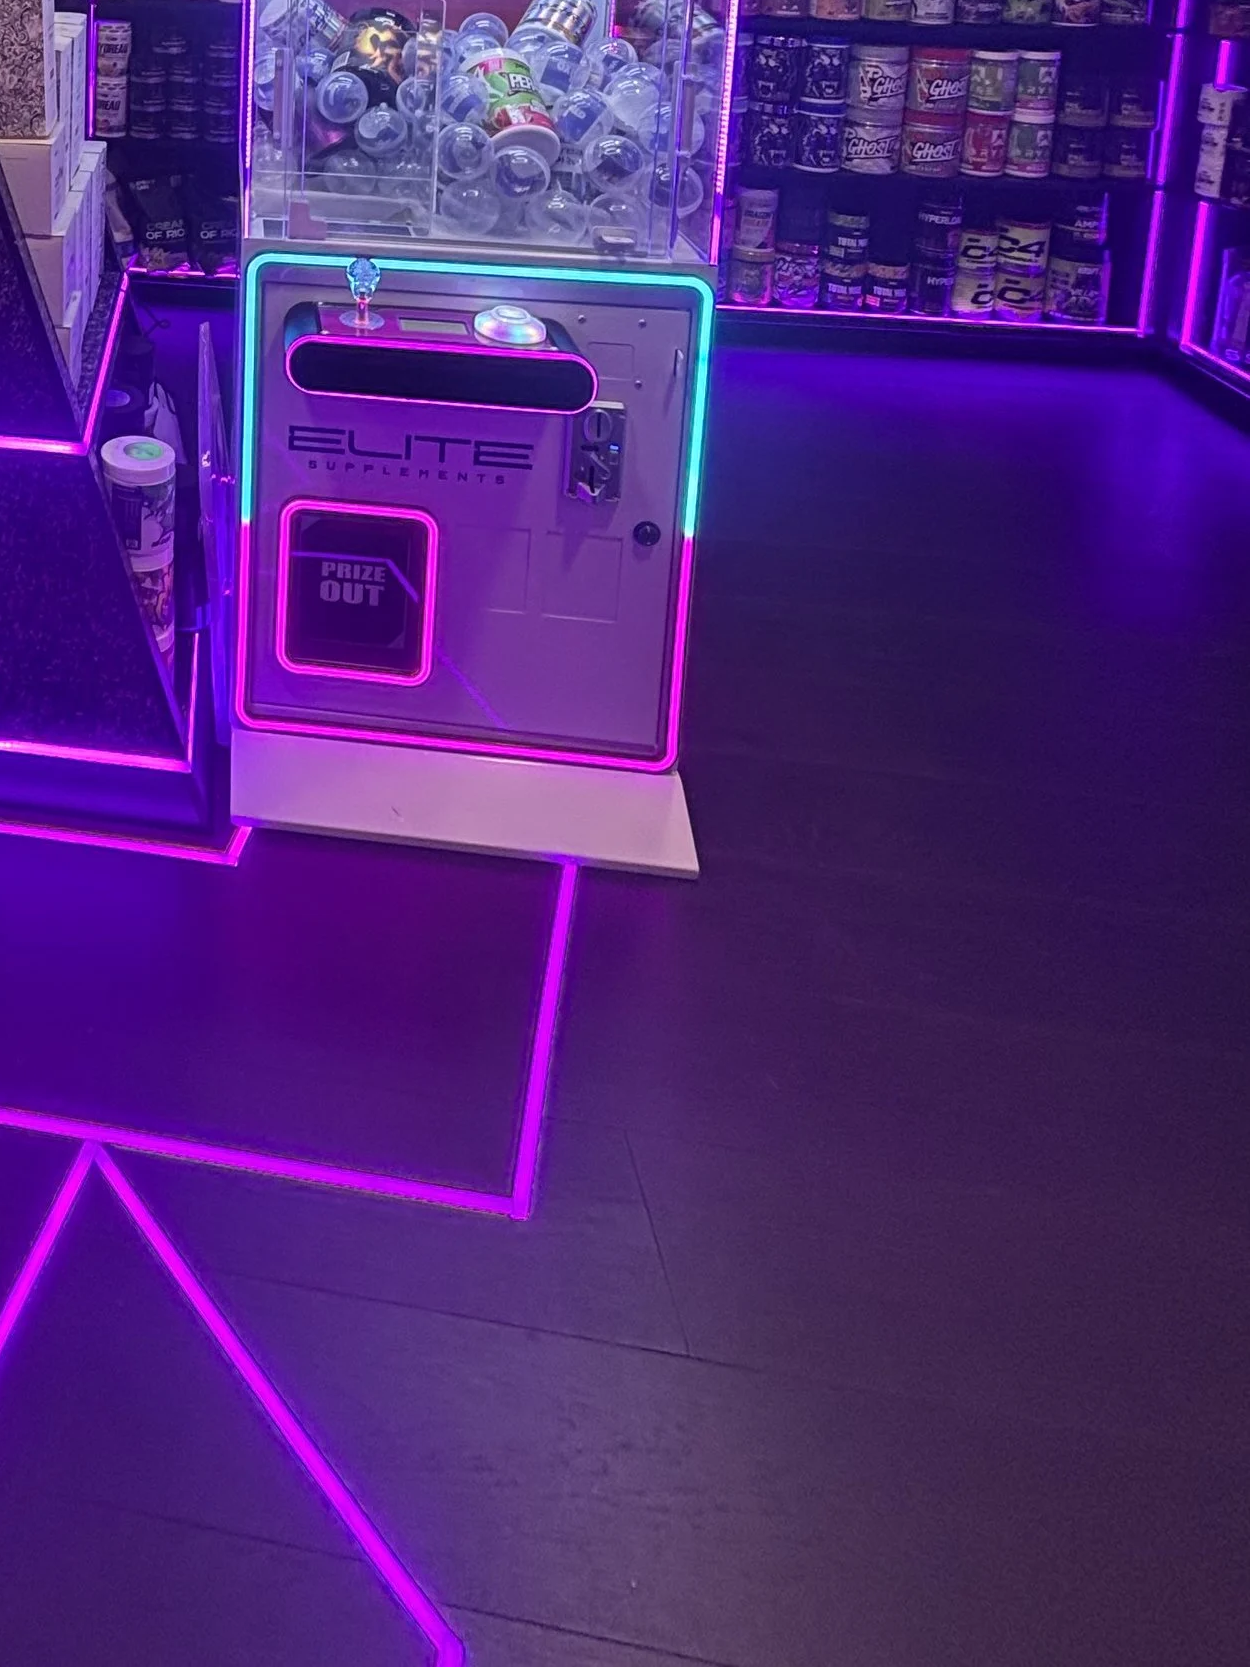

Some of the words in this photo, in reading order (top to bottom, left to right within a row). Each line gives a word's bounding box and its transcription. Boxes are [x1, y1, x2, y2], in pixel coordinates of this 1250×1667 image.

[847, 136, 894, 158] GHOST
[912, 139, 961, 162] GHOST
[1000, 234, 1047, 257] C4
[288, 424, 535, 471] ELITE
[307, 459, 506, 485] SUPPLEMENTS
[321, 560, 387, 583] PRIZE
[319, 579, 386, 607] OUT
